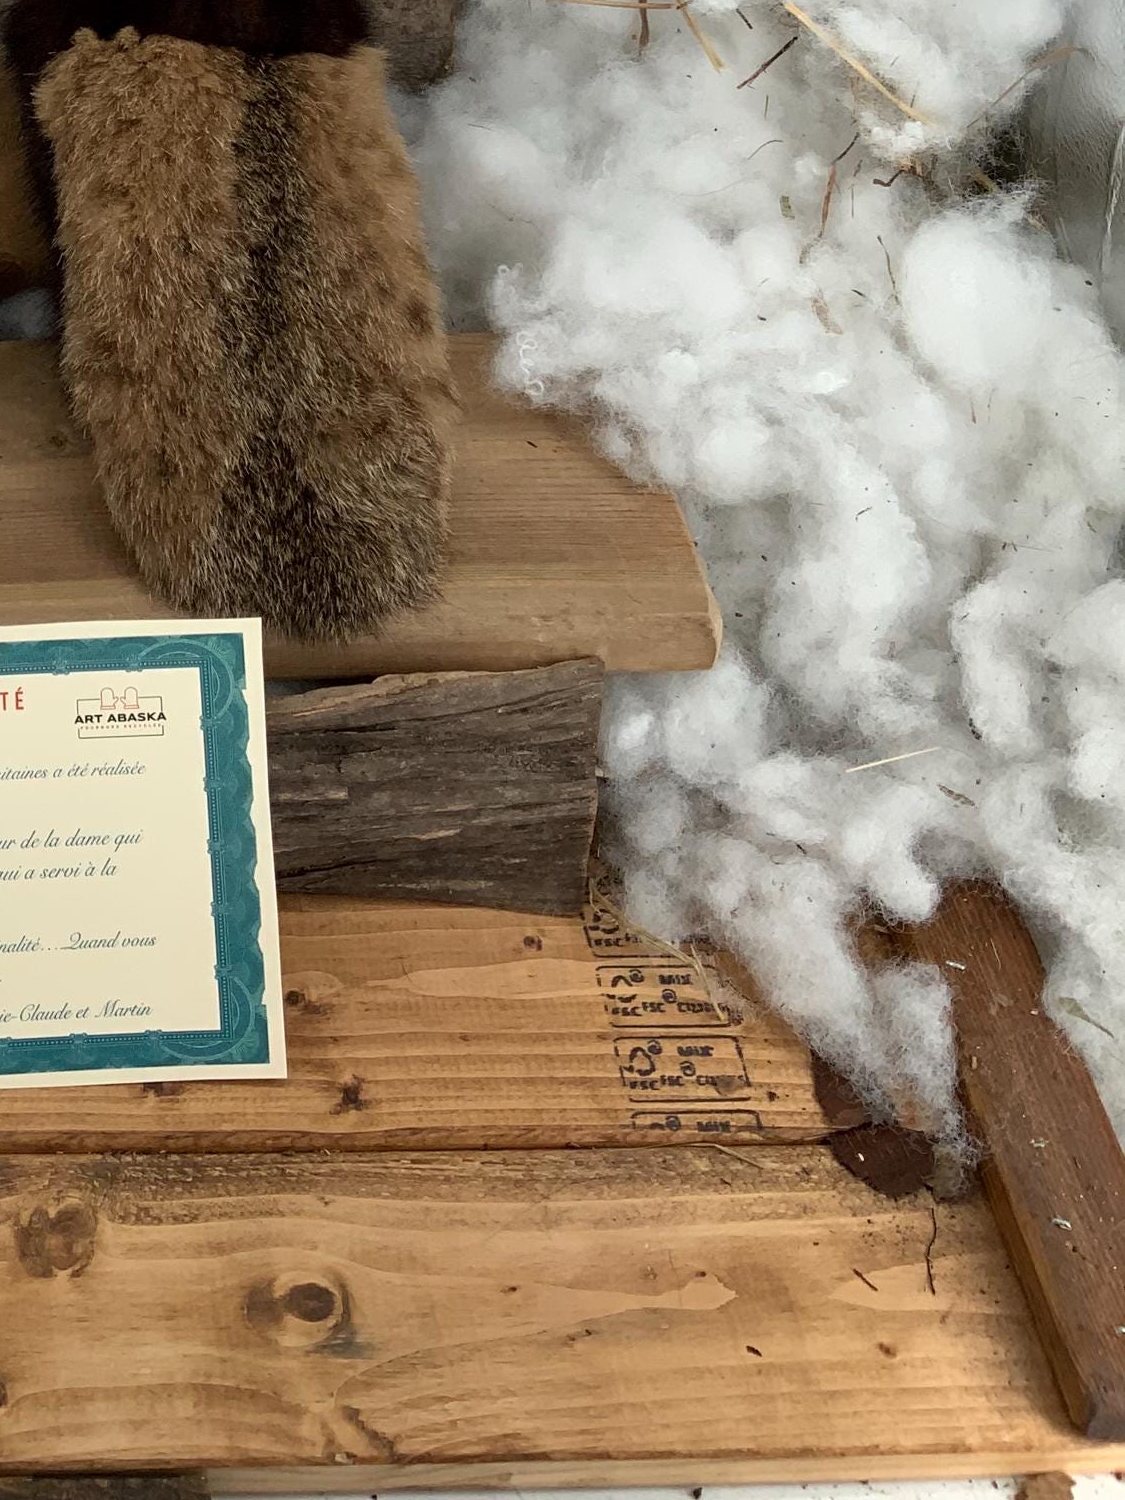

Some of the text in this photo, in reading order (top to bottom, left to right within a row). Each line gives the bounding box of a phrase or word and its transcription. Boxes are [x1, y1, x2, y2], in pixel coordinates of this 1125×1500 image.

[75, 711, 167, 724] ART ABASKA
[53, 768, 64, 778] a
[67, 763, 90, 777] été
[91, 758, 147, 776] réalisée
[20, 830, 40, 850] de
[43, 829, 60, 848] la
[64, 828, 111, 847] dame
[114, 829, 144, 852] qui
[24, 868, 36, 880] a
[39, 864, 81, 879] servi
[84, 862, 96, 877] à
[100, 857, 118, 876] la
[121, 935, 156, 947] vous
[75, 1007, 90, 1018] et
[94, 1000, 154, 1018] Martin
